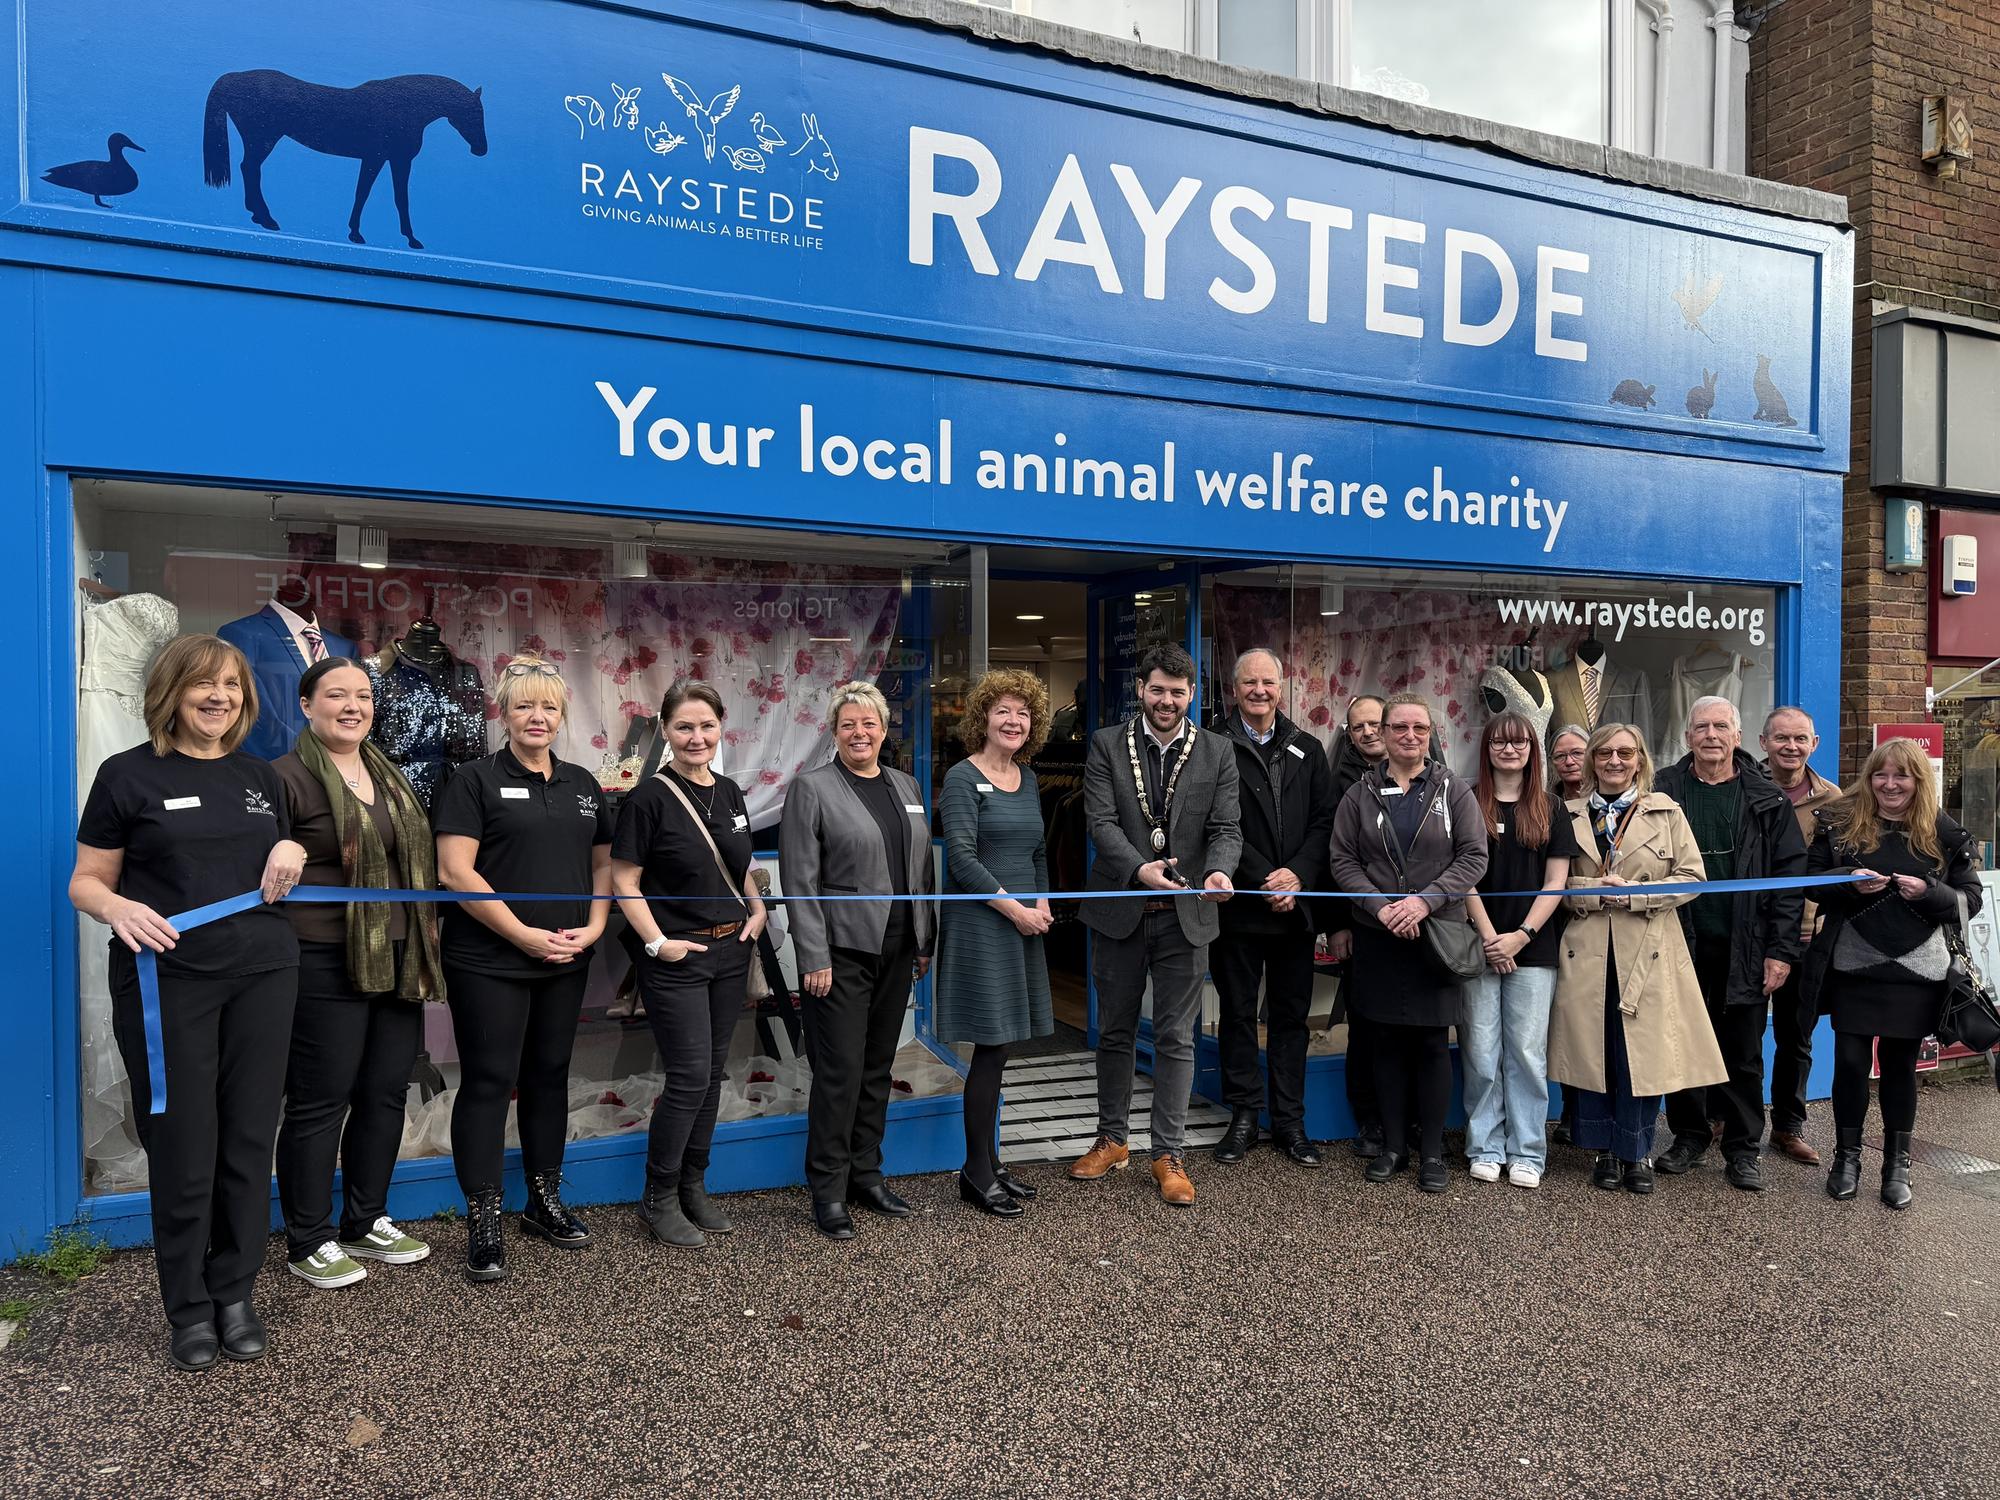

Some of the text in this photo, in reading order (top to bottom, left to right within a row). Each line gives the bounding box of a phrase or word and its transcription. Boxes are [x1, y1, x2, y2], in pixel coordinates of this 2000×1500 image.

[581, 162, 824, 230] RAYSTEDE
[582, 204, 824, 250] GIVING ANIMALS A BETTER LIFE
[909, 126, 1590, 362] RAYSTEDE
[595, 381, 1569, 553] Your local animal welfare charity
[1498, 591, 1766, 646] www.raystede.org
